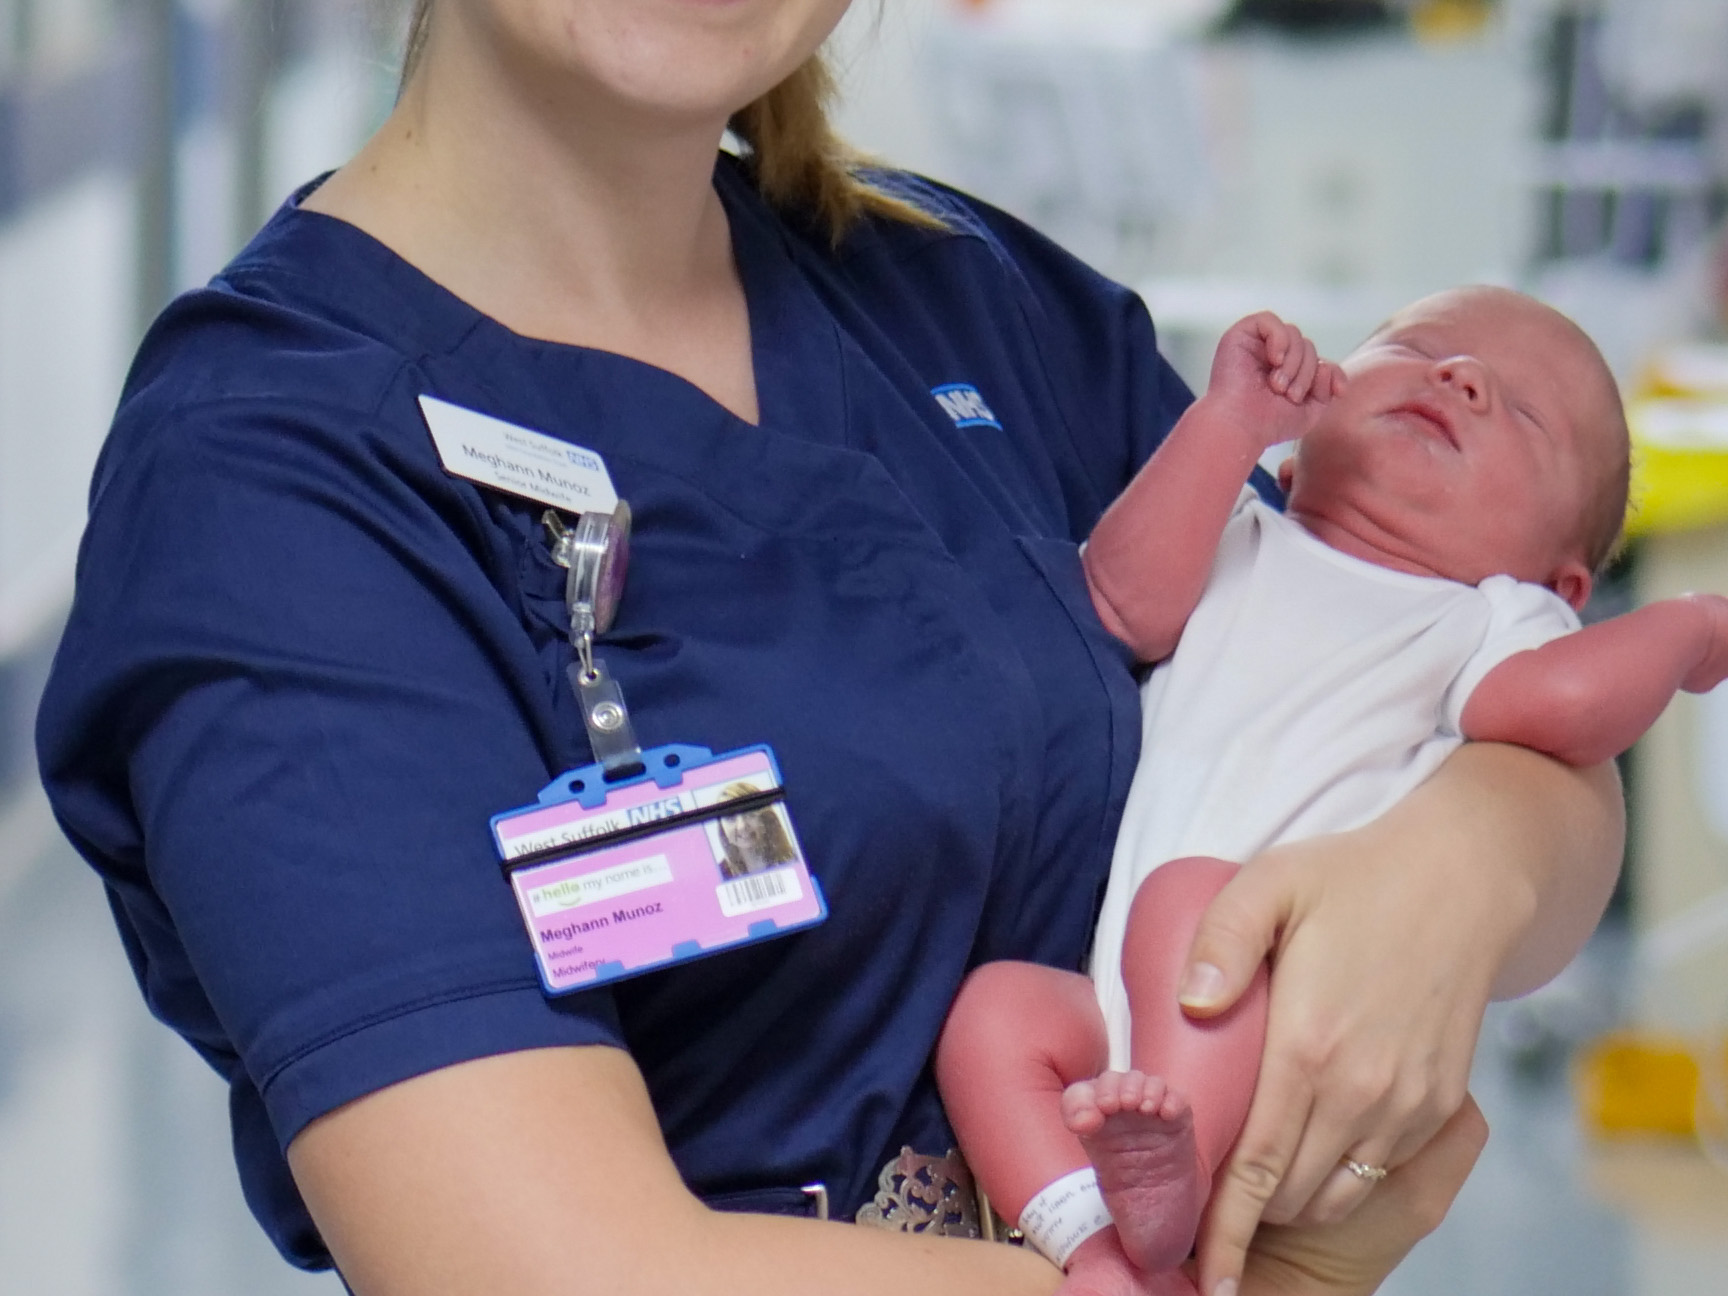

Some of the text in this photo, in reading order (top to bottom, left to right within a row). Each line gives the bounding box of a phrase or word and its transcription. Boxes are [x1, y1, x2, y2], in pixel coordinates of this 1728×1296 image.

[934, 390, 995, 421] NHS
[462, 444, 536, 479] Meghann
[538, 468, 592, 497] Munoz
[514, 798, 684, 856] West Suffolk NHS
[582, 878, 603, 892] my
[605, 867, 641, 885] name
[540, 901, 664, 944] Meghann Munoz
[548, 945, 583, 960] Midwife
